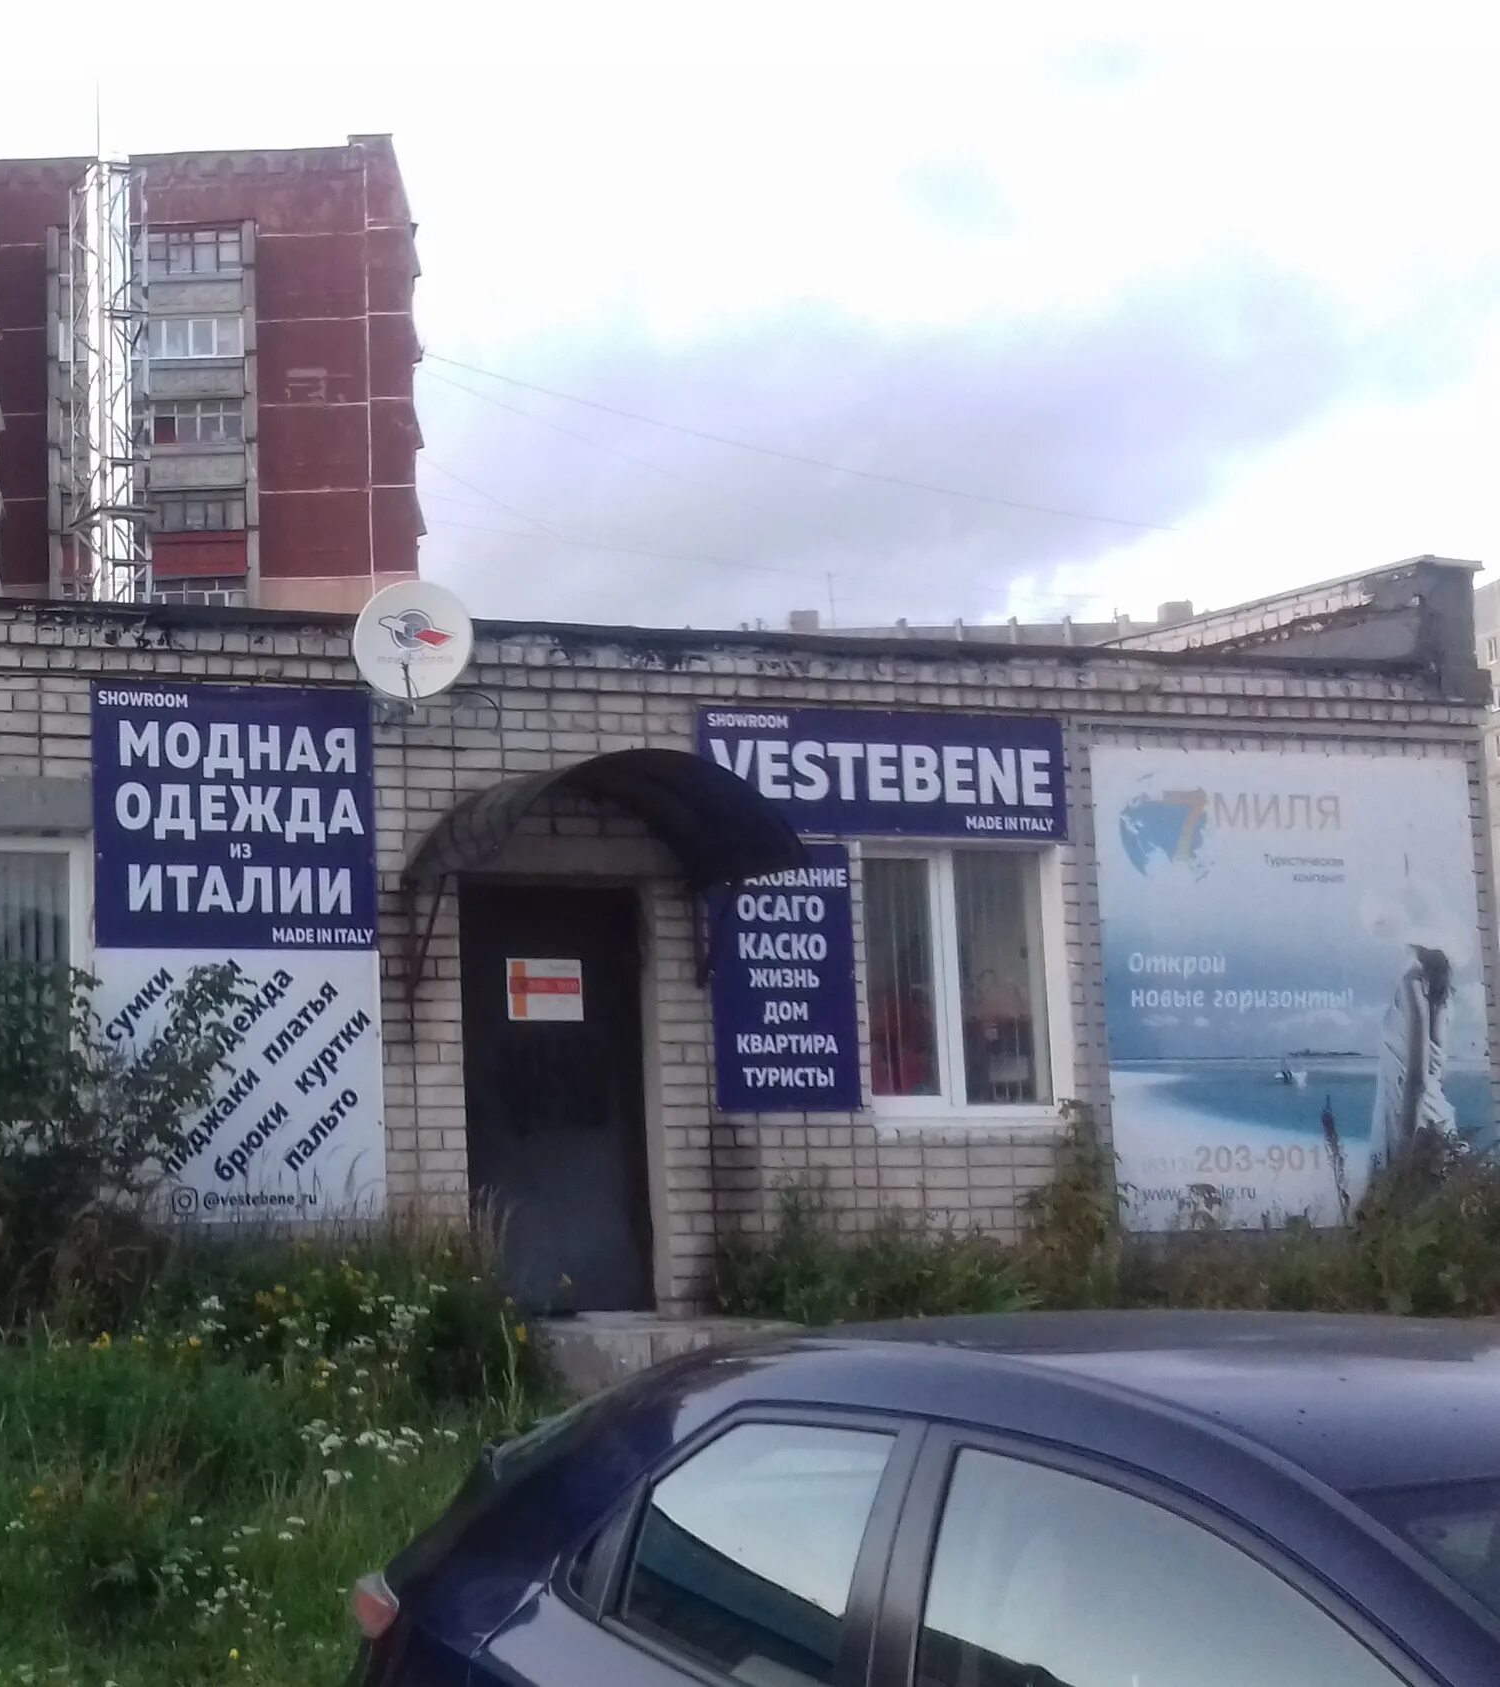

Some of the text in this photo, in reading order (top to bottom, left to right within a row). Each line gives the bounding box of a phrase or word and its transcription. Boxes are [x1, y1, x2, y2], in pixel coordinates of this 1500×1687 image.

[98, 690, 188, 708] SHOWROOM
[707, 713, 789, 729] SHOWROOM
[119, 720, 357, 779] МОДНАЯ
[709, 738, 1054, 807] VESTEBENE
[114, 781, 365, 844] ОДЕЖДА
[965, 815, 1054, 832] MADE IN ITALY
[1213, 792, 1341, 831] МИЛЯ
[127, 864, 351, 915] ИТАЛИИ
[736, 893, 826, 923] ОСАГО
[272, 927, 374, 945] MADE IN ITALY
[737, 932, 828, 962] КАСКО
[749, 967, 820, 989] ЖИЗНЬ
[1128, 951, 1226, 979] Открой
[104, 966, 175, 1042] сумки
[763, 1001, 809, 1025] ДОМ
[1131, 986, 1354, 1012] новые горизонты!
[261, 980, 340, 1066] платья
[293, 1008, 373, 1096] куртки
[736, 1033, 840, 1055] КВАРТИРА
[742, 1067, 835, 1088] ТУРИСТЫ
[164, 1067, 262, 1174] пиджаки
[283, 1087, 359, 1173] пальто
[213, 1101, 291, 1182] брюки
[1195, 1144, 1321, 1174] 203-901
